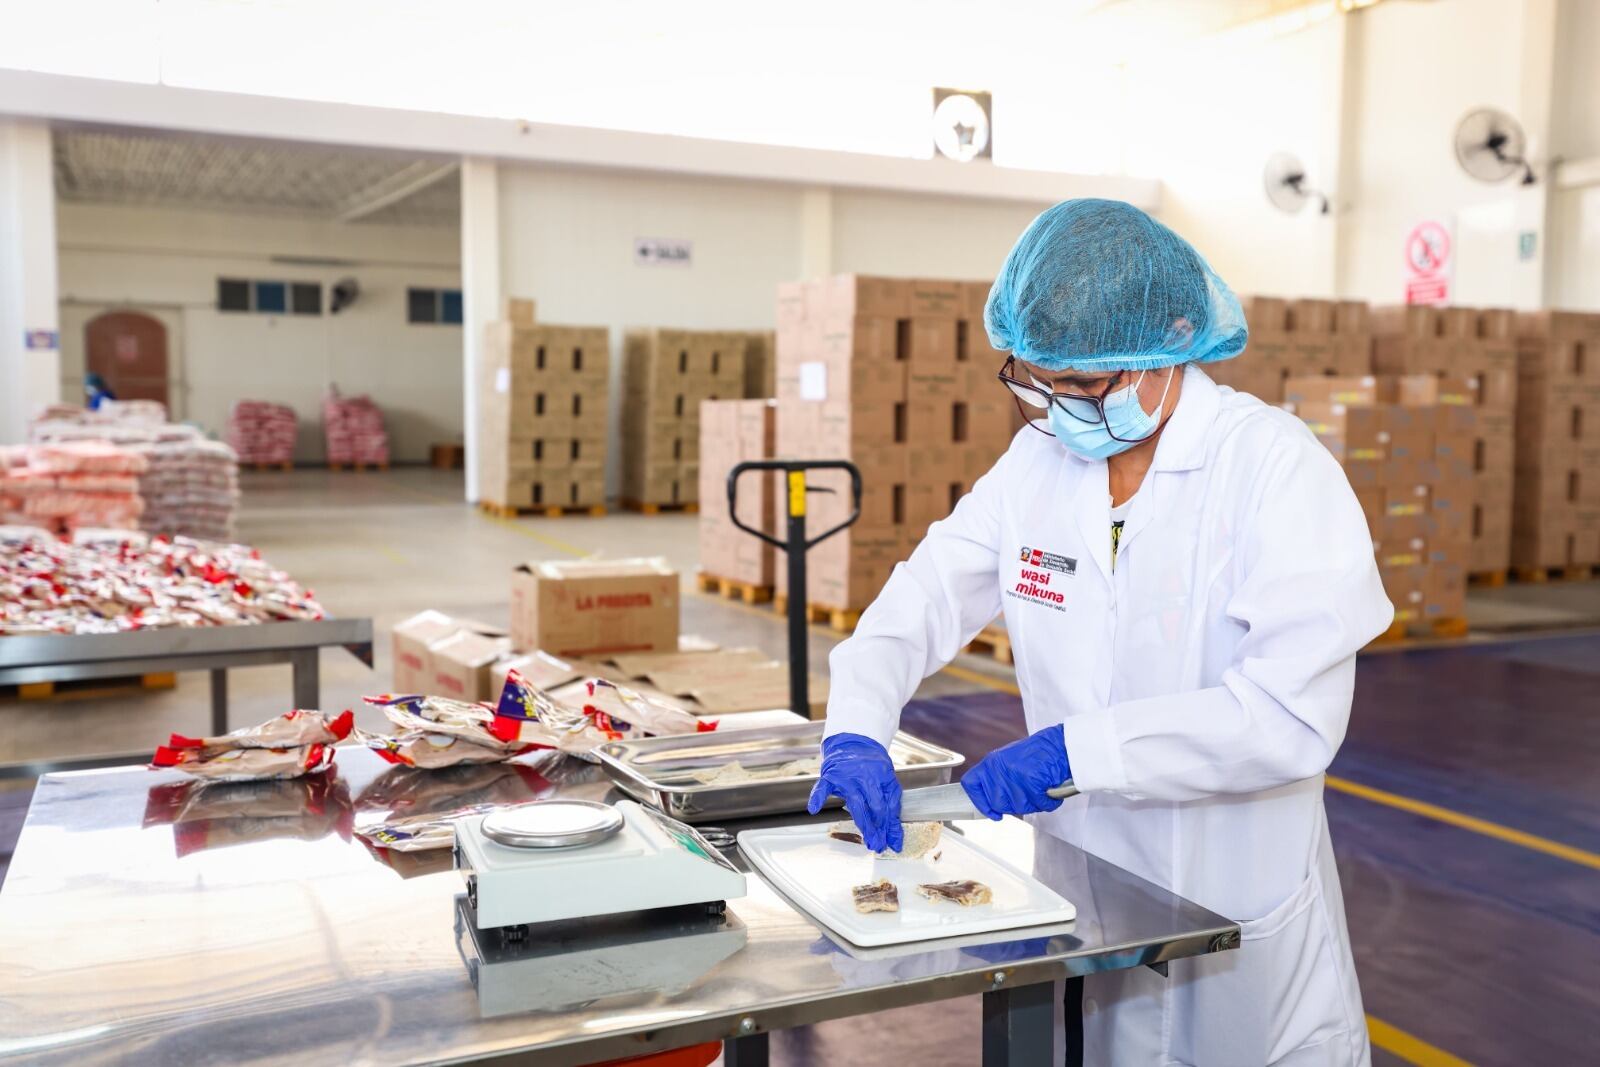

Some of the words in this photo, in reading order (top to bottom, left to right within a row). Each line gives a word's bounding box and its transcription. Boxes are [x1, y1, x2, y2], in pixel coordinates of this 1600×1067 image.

[1021, 569, 1050, 585] wasi
[1015, 583, 1064, 603] mikuna
[575, 594, 593, 611] LA
